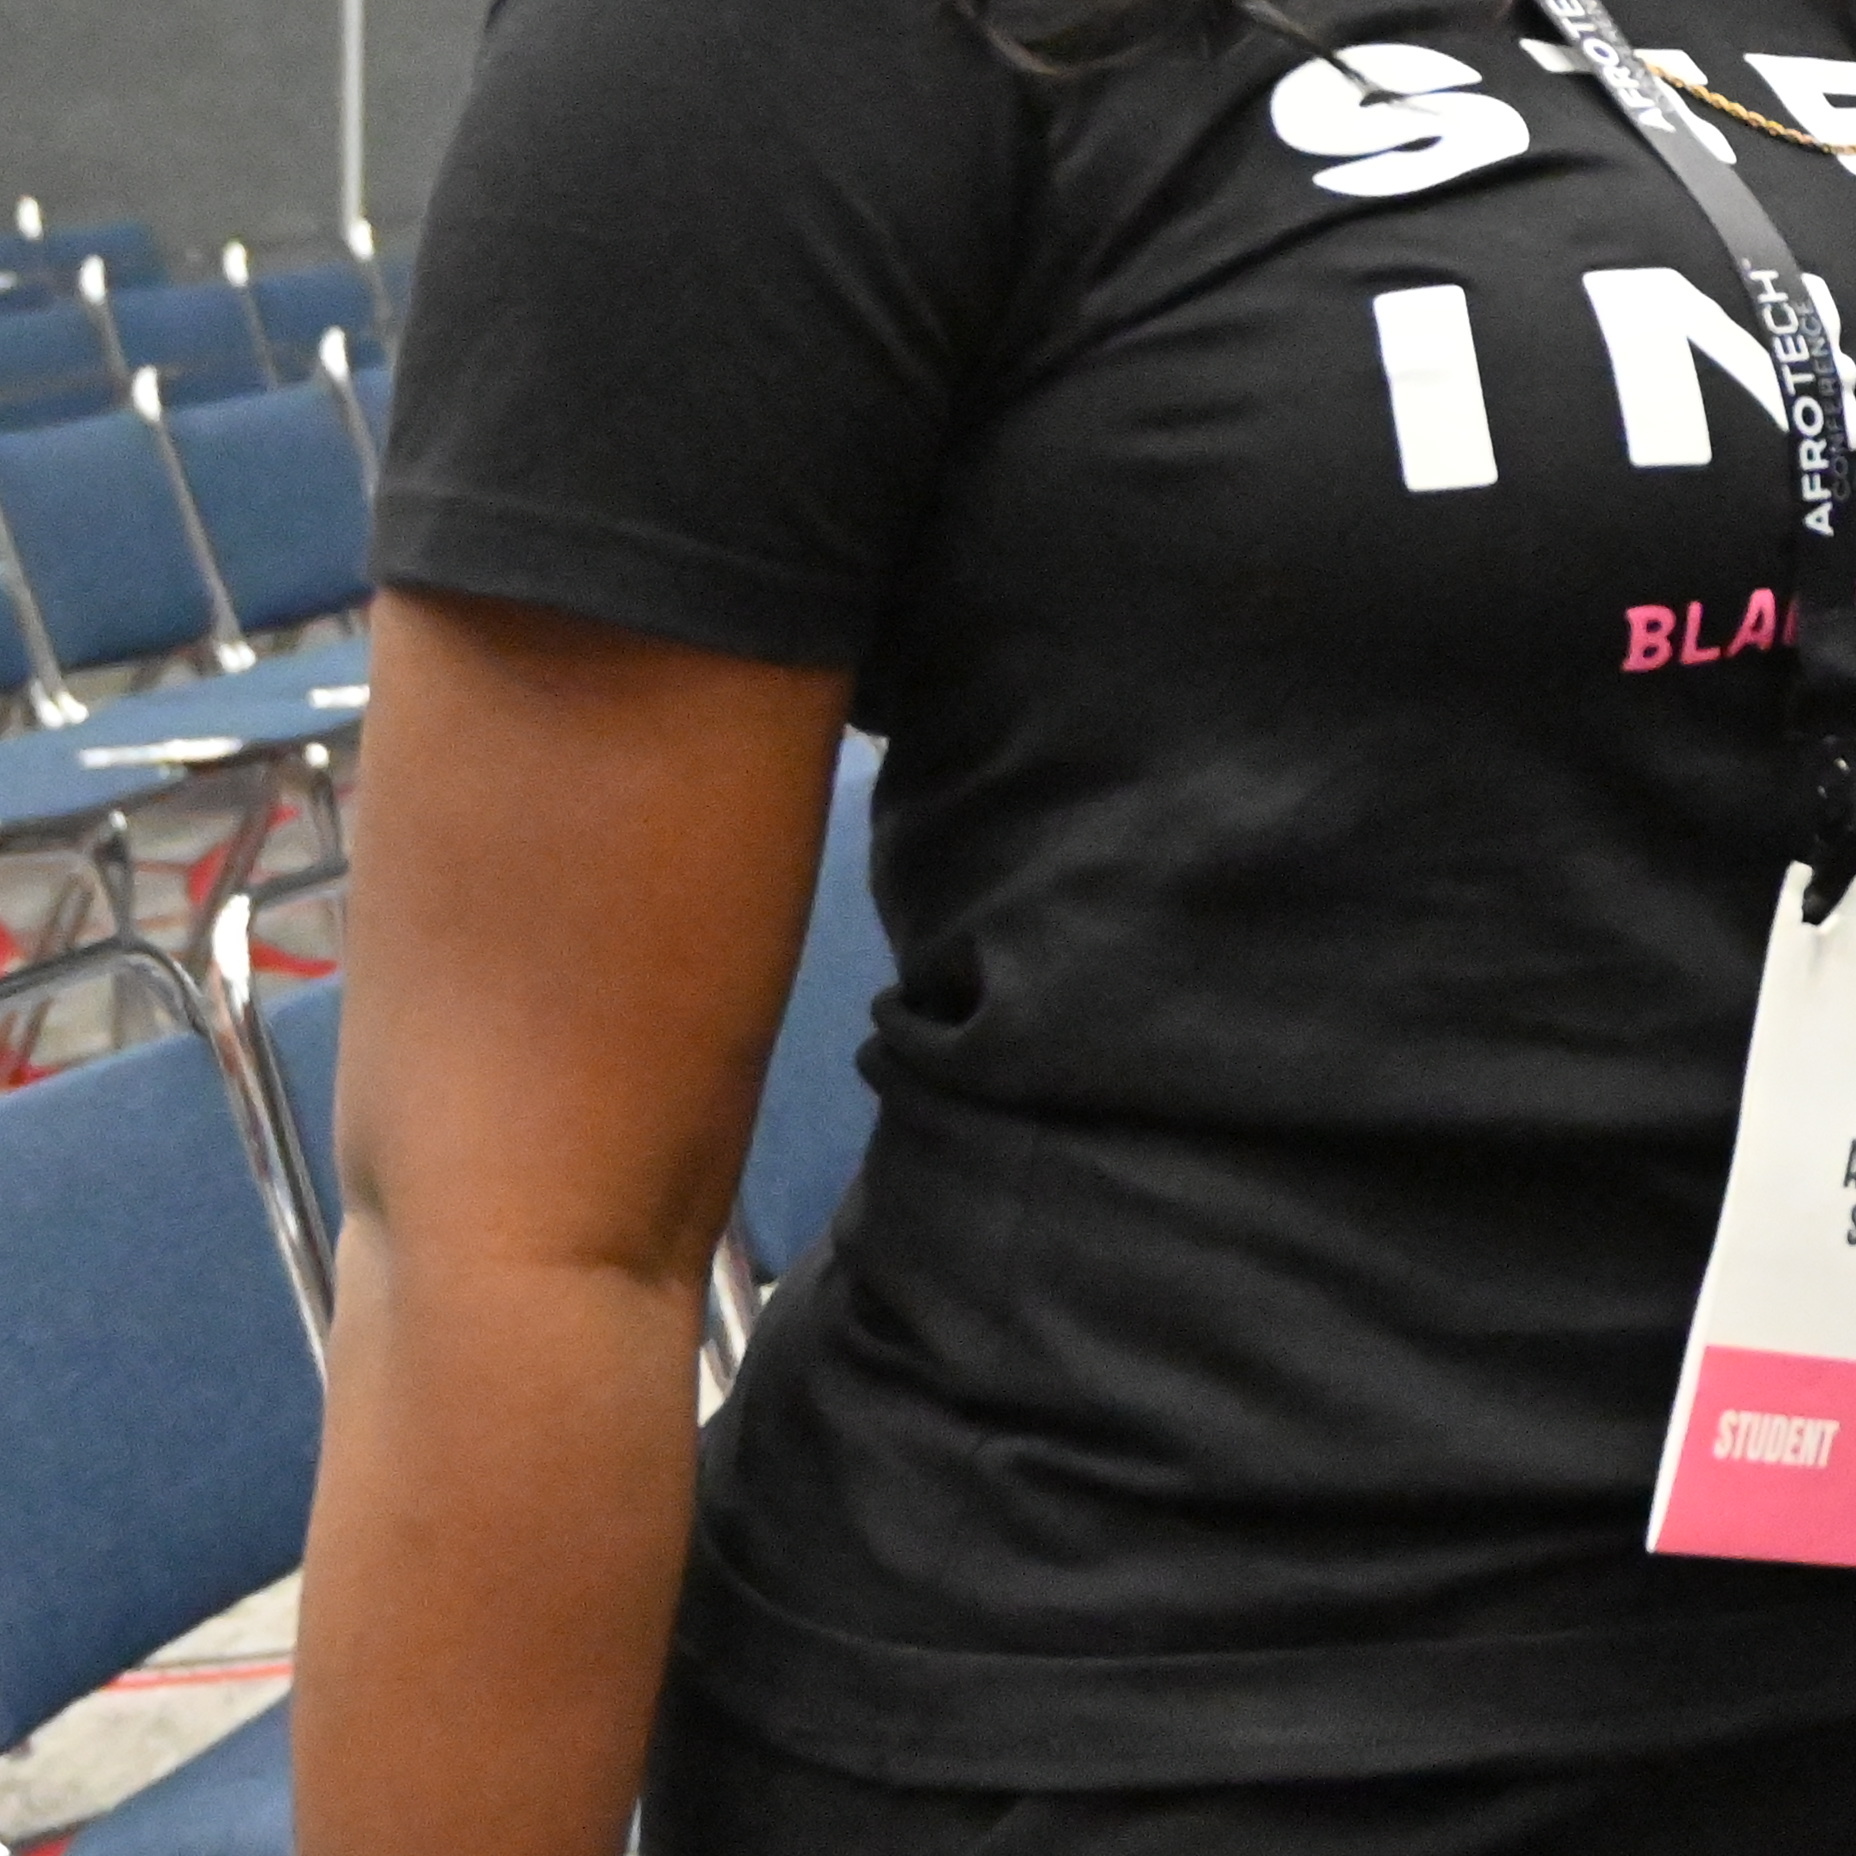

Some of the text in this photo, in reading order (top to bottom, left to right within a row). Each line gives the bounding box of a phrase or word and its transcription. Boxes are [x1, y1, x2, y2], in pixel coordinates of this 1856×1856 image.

[1749, 269, 1835, 537] AFROTECH
[1797, 298, 1850, 502] CONFERENCE
[1713, 1409, 1840, 1469] STUDENT
